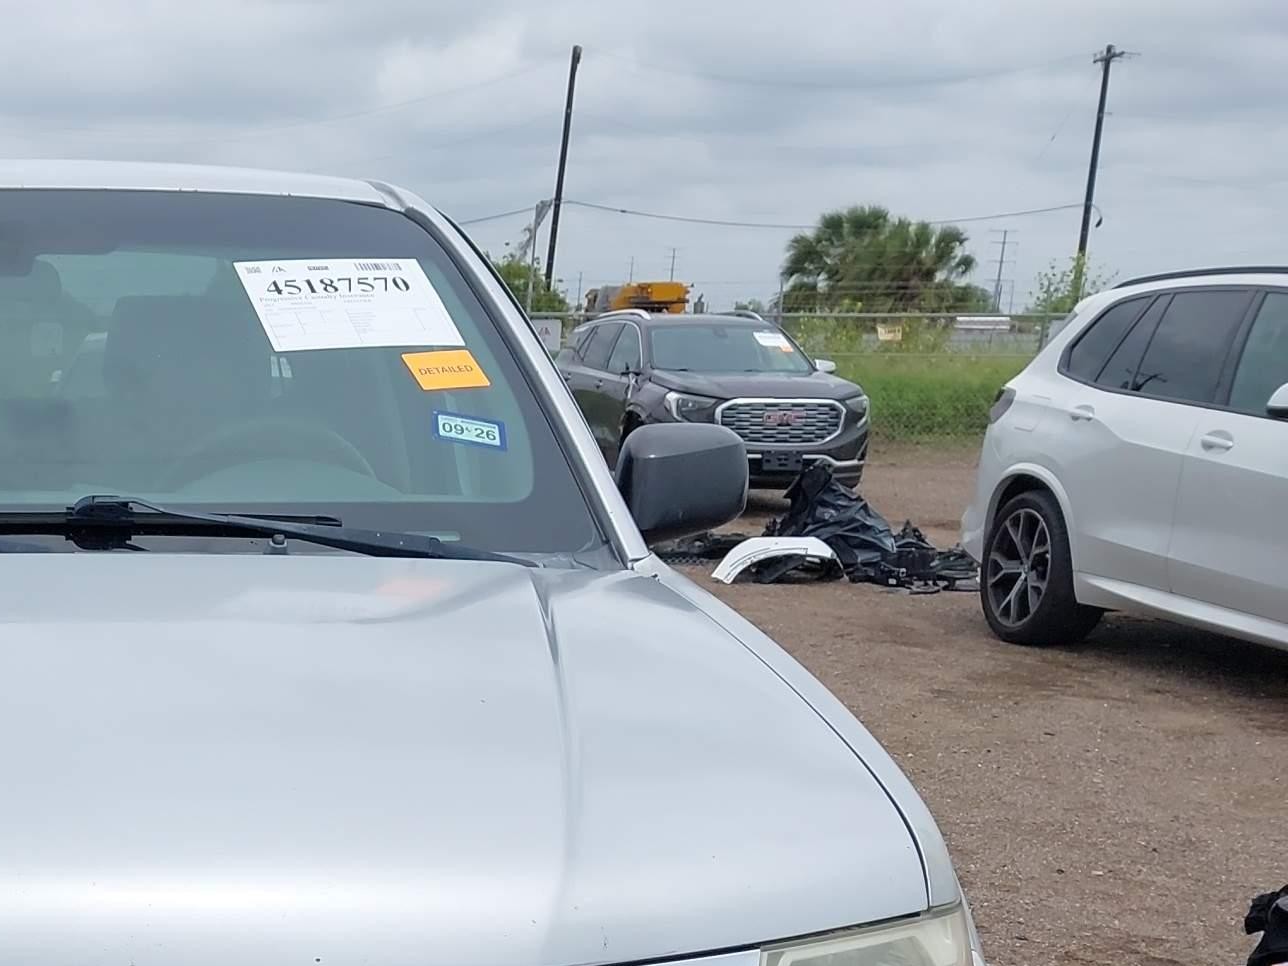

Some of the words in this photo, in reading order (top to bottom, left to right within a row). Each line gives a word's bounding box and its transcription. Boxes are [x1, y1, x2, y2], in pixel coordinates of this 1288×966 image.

[266, 276, 410, 295] 45187570
[418, 364, 473, 376] DETAILED
[442, 422, 465, 435] 09
[474, 427, 497, 441] 26
